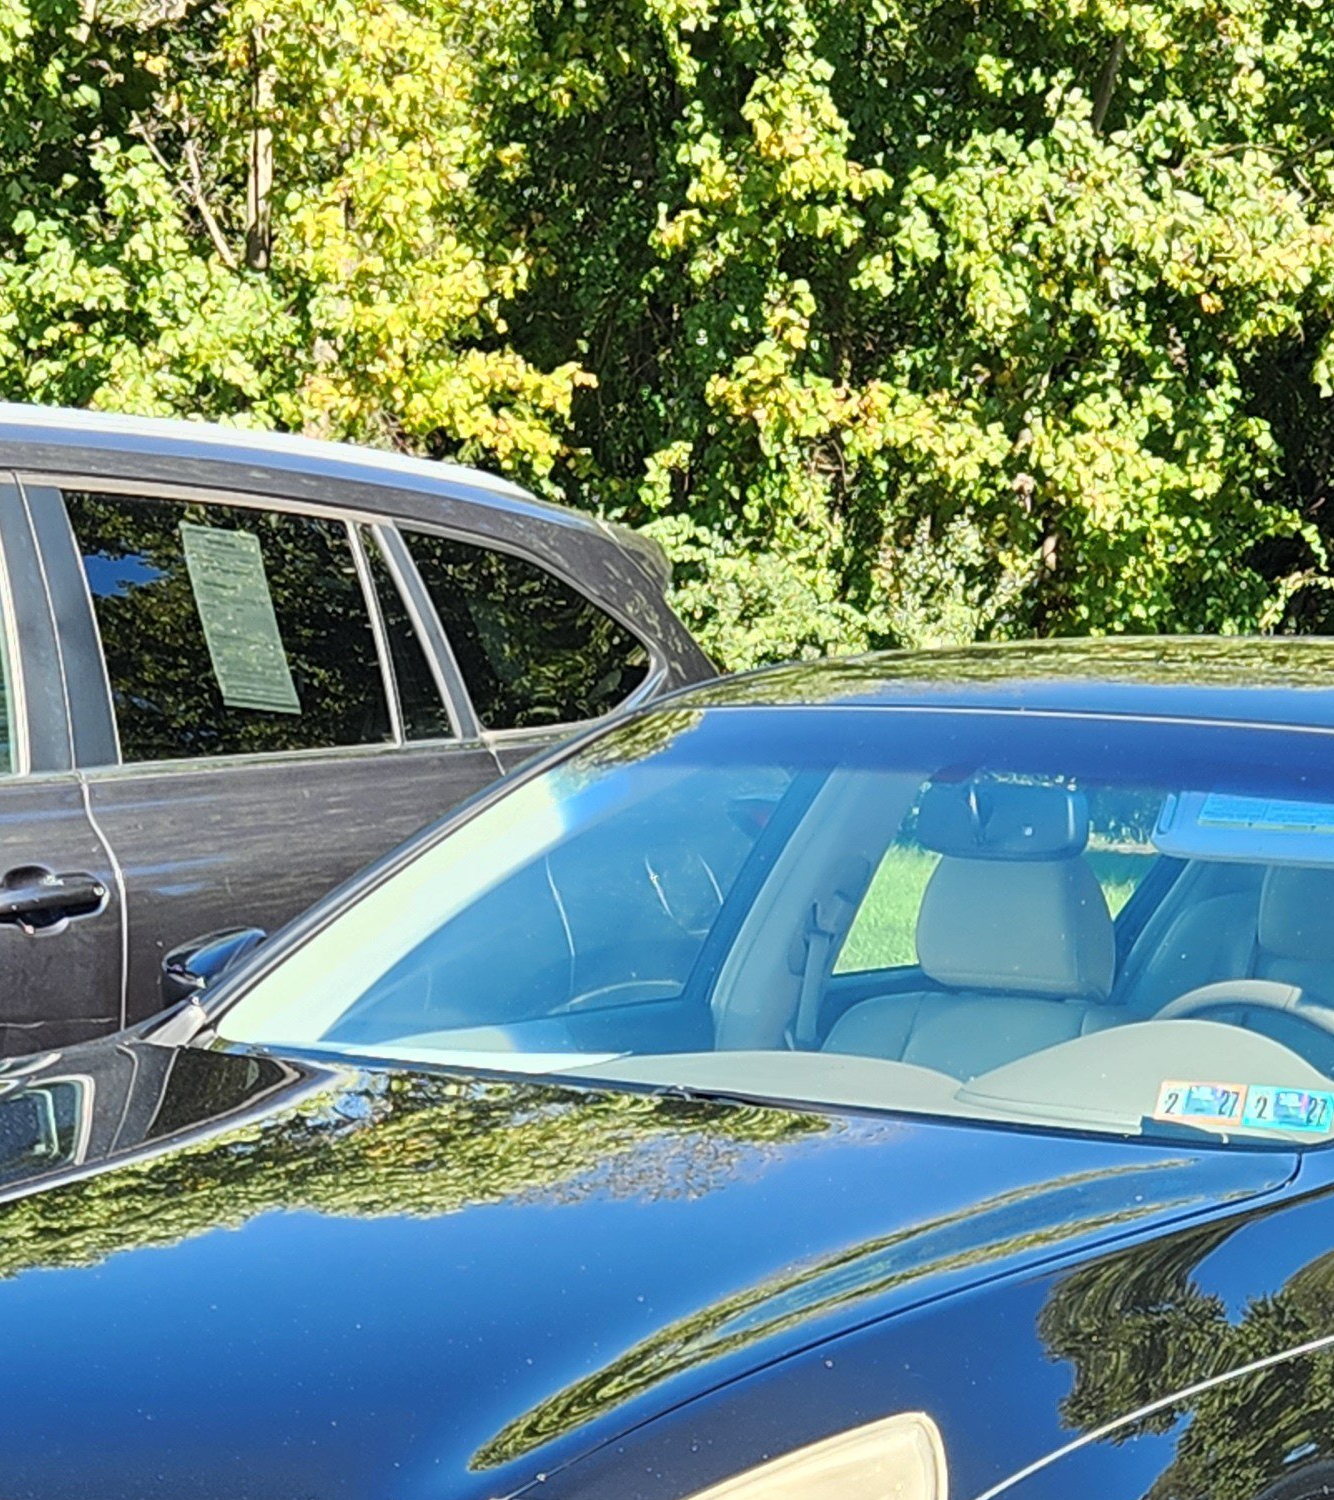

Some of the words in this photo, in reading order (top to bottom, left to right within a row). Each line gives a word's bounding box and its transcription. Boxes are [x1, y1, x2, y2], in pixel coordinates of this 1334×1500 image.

[1164, 1091, 1179, 1115] 2
[1218, 1089, 1241, 1118] 27
[1254, 1095, 1268, 1120] 2
[1305, 1097, 1328, 1126] 27
